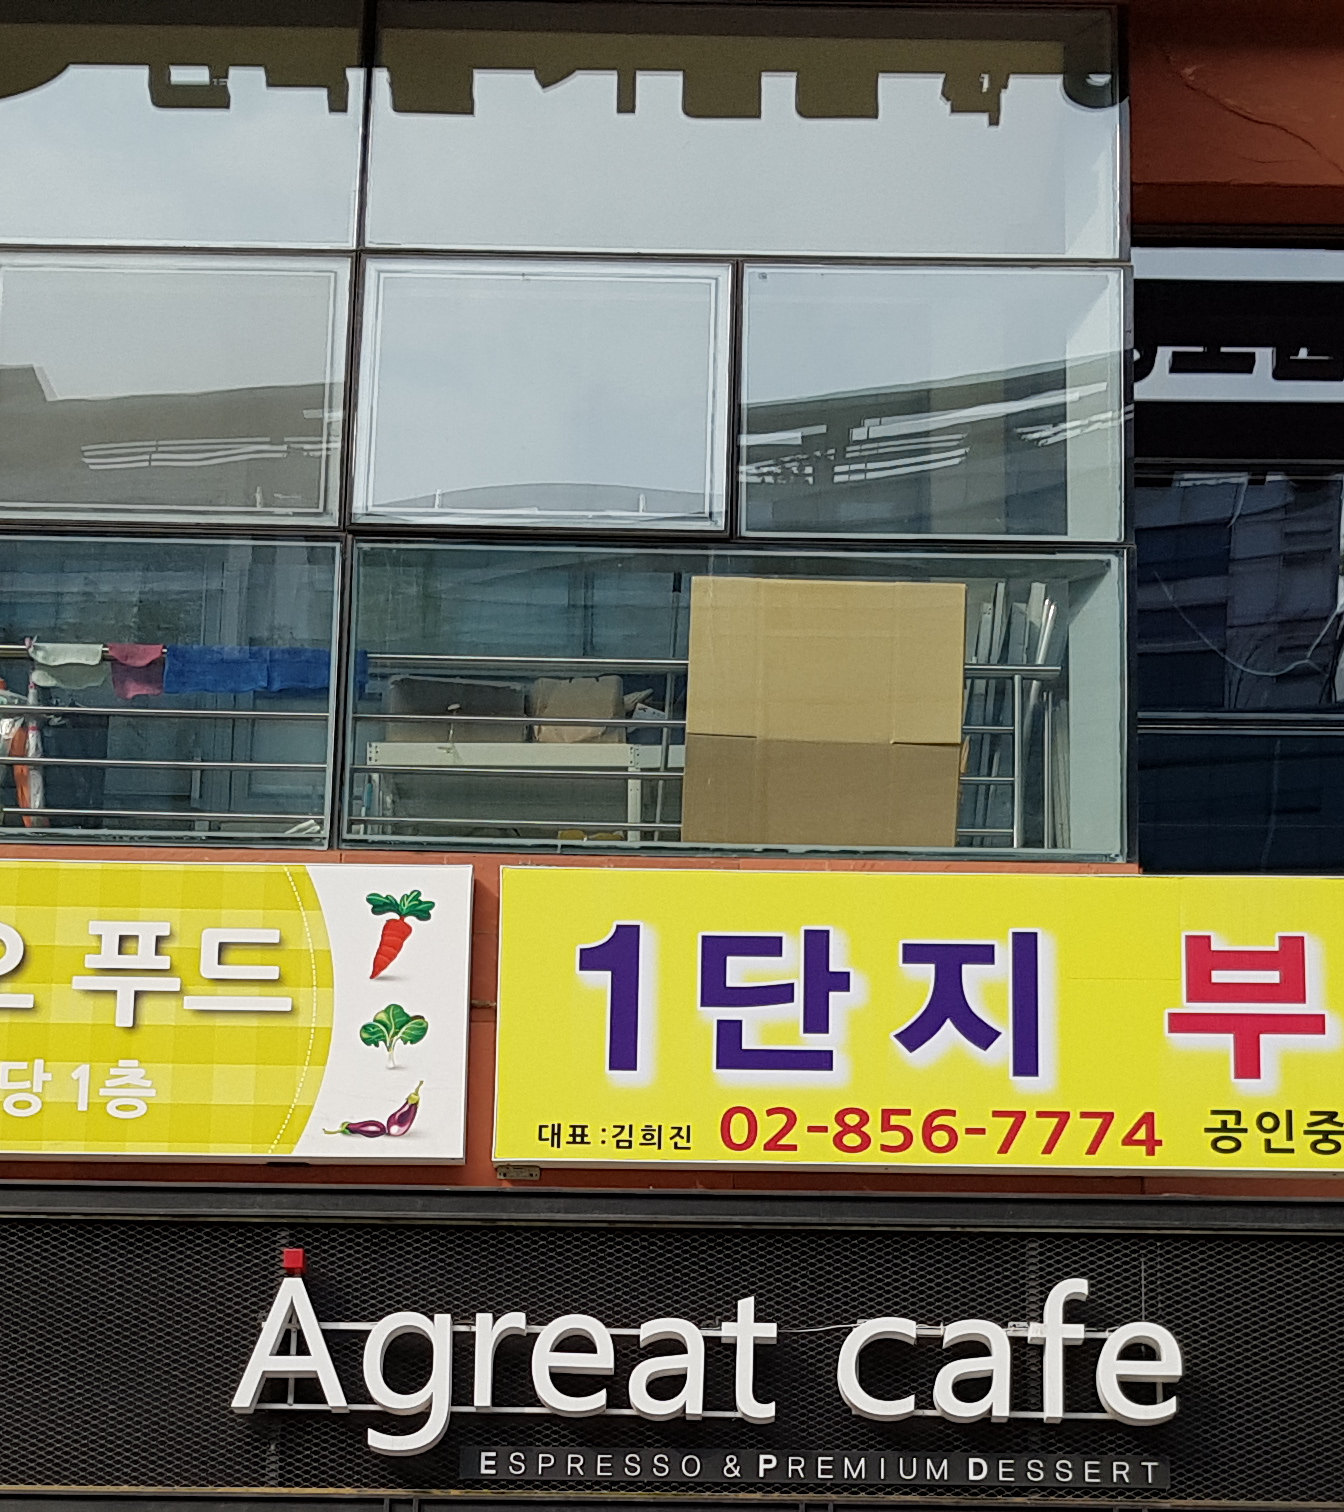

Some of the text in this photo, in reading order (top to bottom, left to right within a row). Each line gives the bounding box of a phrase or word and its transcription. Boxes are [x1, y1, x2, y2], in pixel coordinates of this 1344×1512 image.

[71, 919, 294, 1029] 푸드
[577, 922, 1040, 1078] 1단지
[70, 1060, 158, 1120] 1층
[720, 1106, 1163, 1157] 02-856-7774
[230, 1252, 1184, 1457] Agreat cafe
[479, 1450, 703, 1478] ESPRESSO
[758, 1453, 951, 1482] PREMIUM
[967, 1456, 1162, 1485] DESSERT
